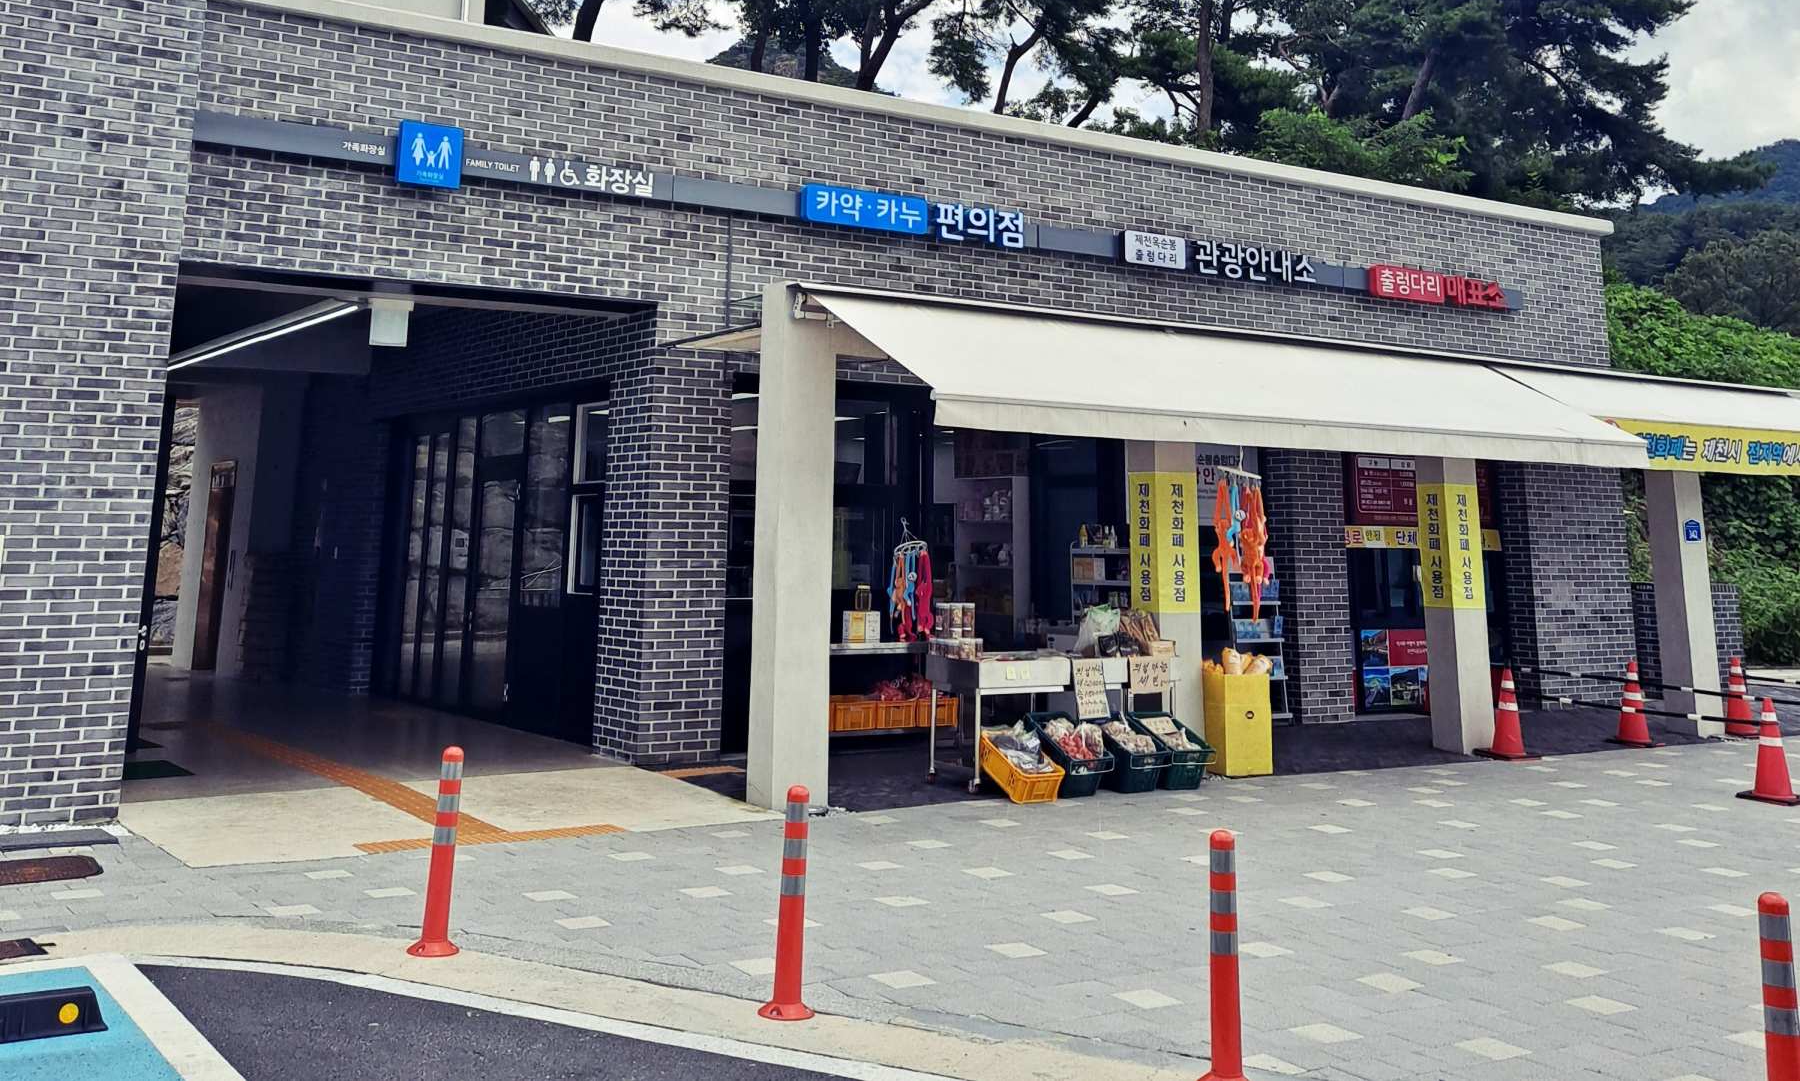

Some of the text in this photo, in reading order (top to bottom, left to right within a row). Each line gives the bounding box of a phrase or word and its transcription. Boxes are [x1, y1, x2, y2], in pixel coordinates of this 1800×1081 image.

[342, 141, 386, 156] 가족화장실
[465, 158, 520, 174] FAMILY TOILET
[584, 164, 654, 198] 화장실
[936, 202, 1024, 249] 편의점
[1135, 249, 1177, 265] 출렁다리
[1195, 239, 1317, 283] 관광안내소
[1380, 269, 1440, 297] 출렁다리
[1445, 275, 1508, 308] 매표소
[1636, 432, 1697, 460] 천화폐는
[1701, 438, 1742, 464] 제천시
[1138, 483, 1152, 602] 제천화폐 사용점
[1170, 483, 1186, 602] 제천화폐 사용점
[1425, 493, 1444, 599] 제천화폐 사용점
[1456, 494, 1473, 600] 제천화폐 사용점
